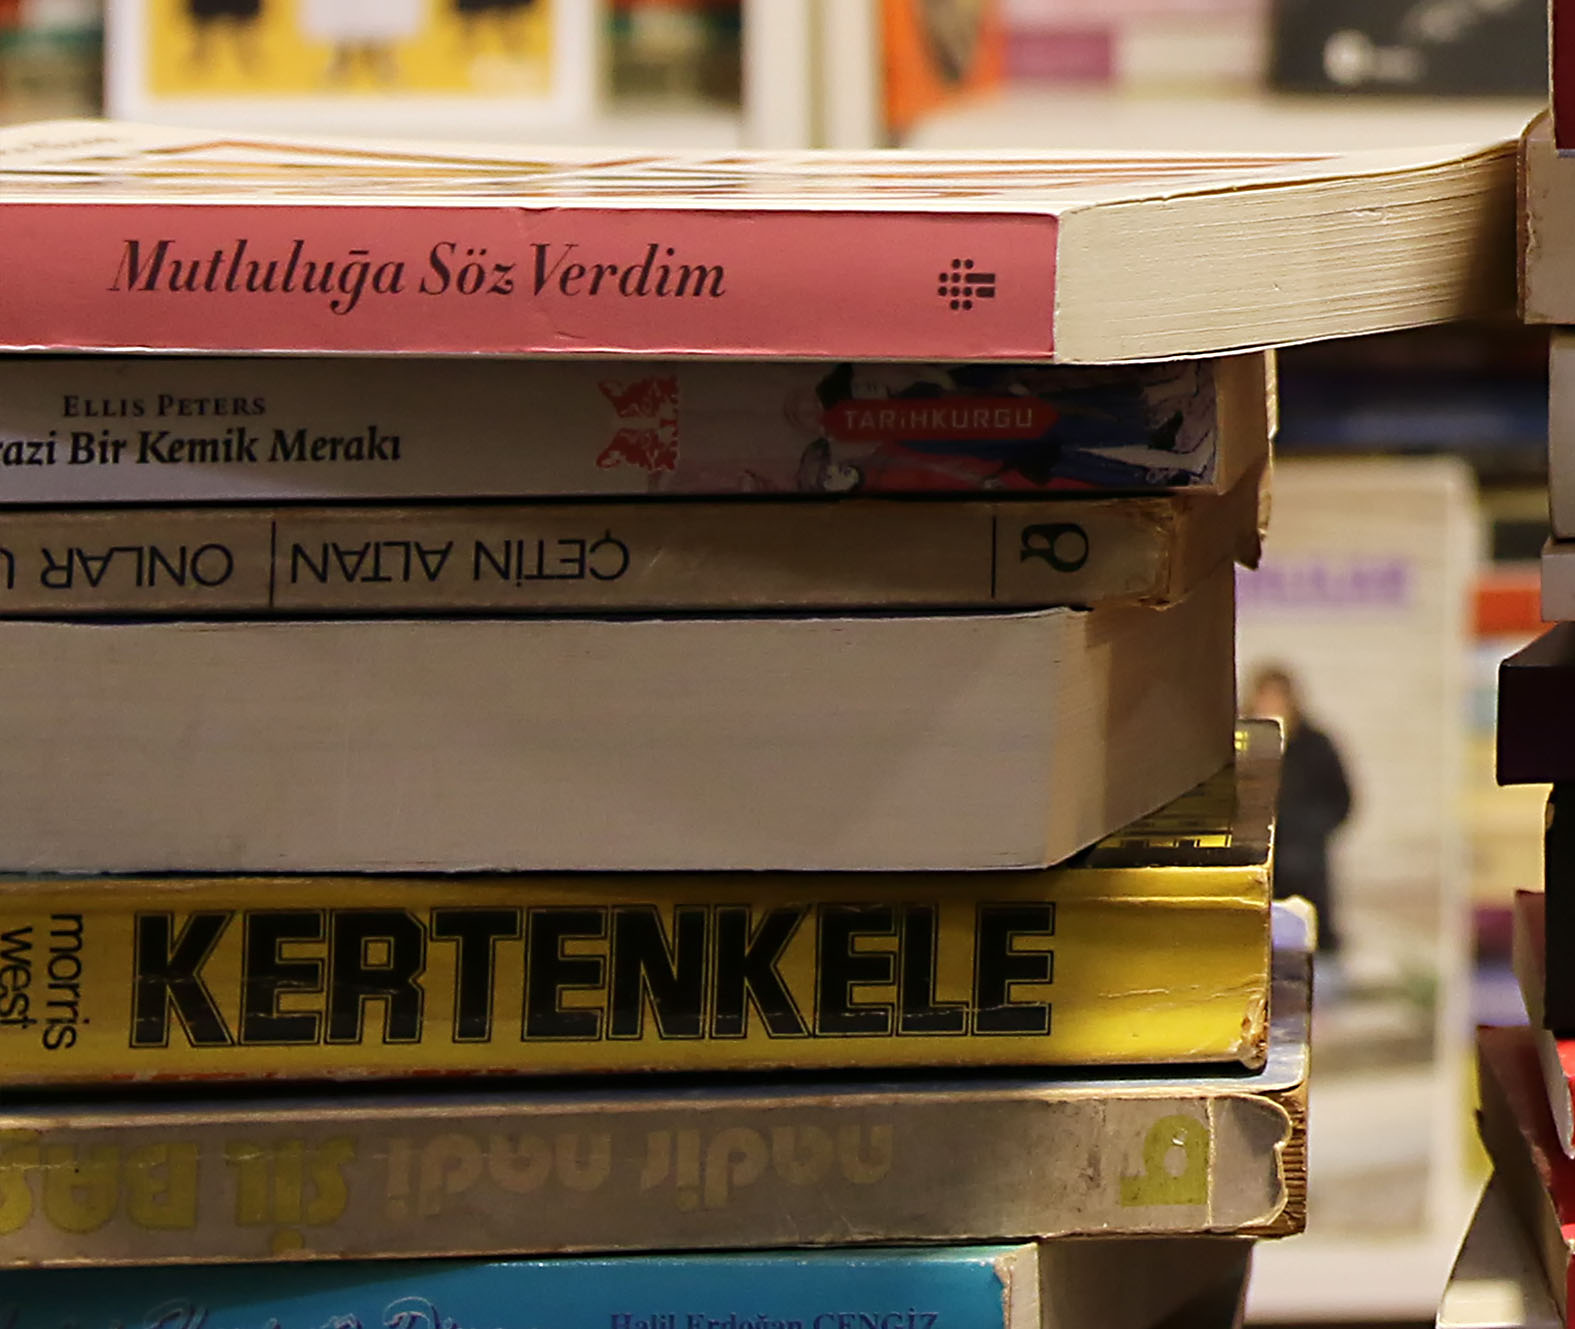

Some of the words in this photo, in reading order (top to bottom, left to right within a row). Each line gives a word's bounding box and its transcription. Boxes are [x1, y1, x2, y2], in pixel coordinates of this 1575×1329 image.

[107, 238, 405, 316] Mutluluğa
[419, 241, 515, 297] Söz
[530, 242, 726, 299] Verdim
[67, 430, 127, 465] Bir
[135, 427, 259, 464] Kemik
[267, 424, 401, 463] Merakı
[40, 543, 234, 589] ONLAR
[291, 541, 454, 583] ALTAN
[473, 530, 629, 588] ÇETİN
[0, 926, 35, 1030] west
[42, 912, 91, 1052] morris
[130, 902, 1055, 1049] KERTENKELE
